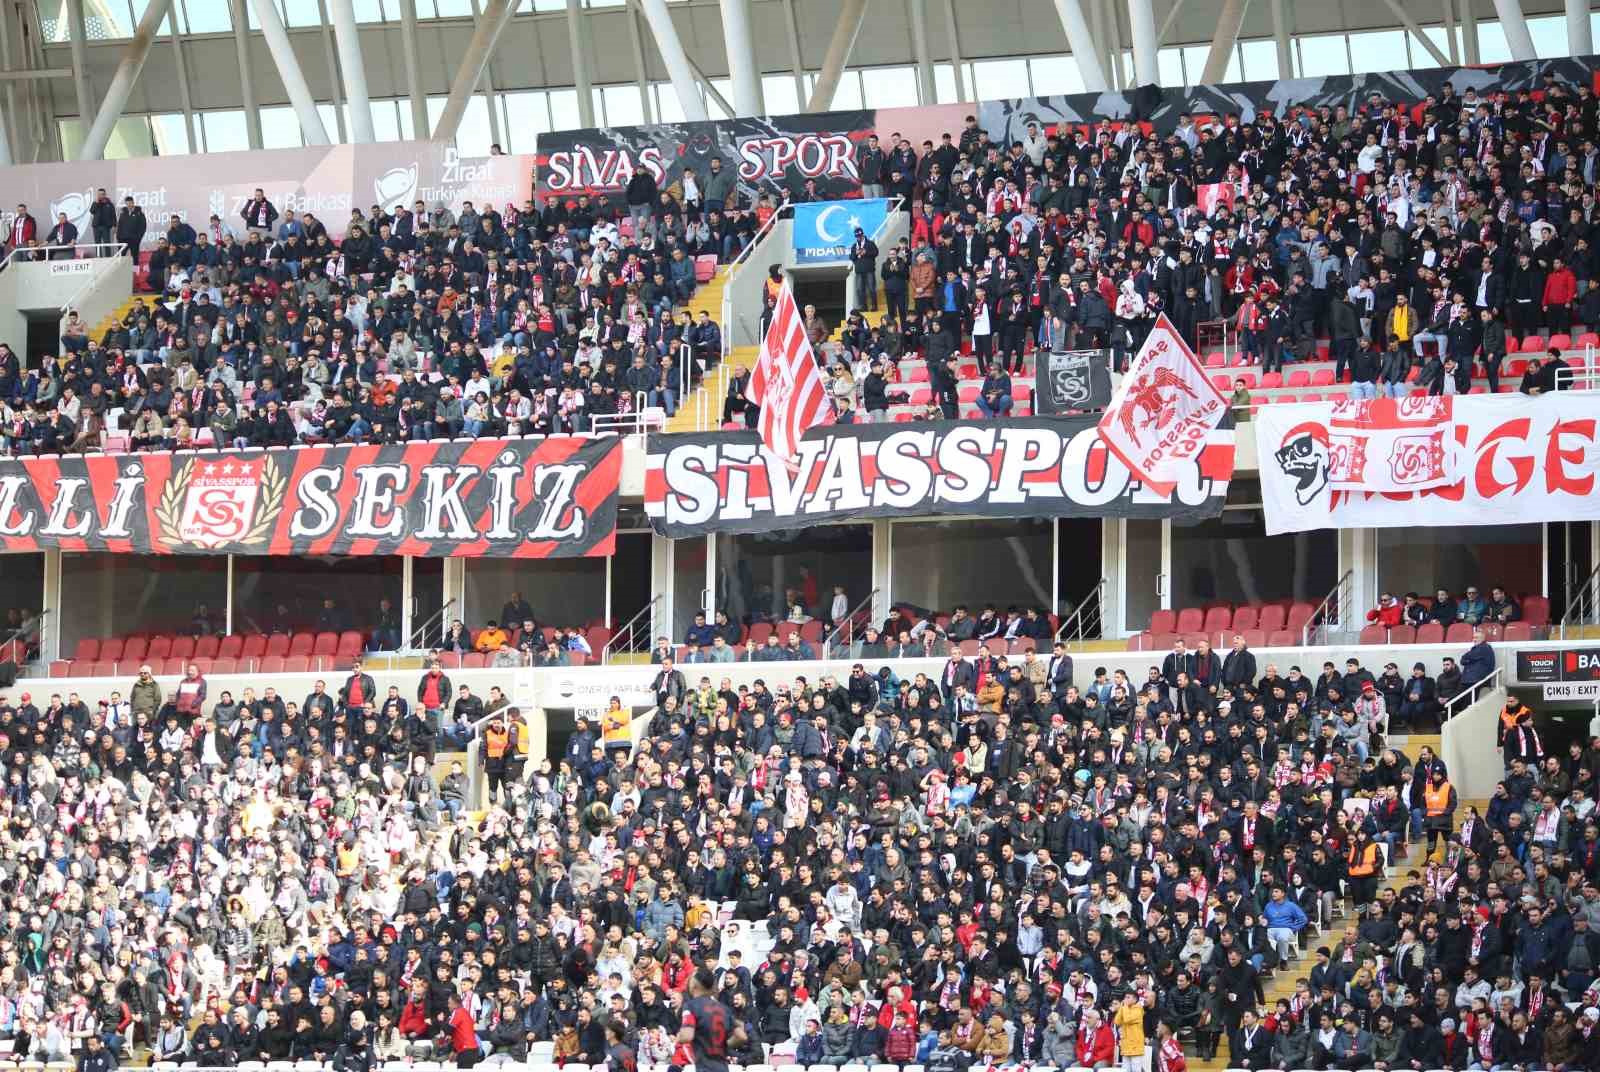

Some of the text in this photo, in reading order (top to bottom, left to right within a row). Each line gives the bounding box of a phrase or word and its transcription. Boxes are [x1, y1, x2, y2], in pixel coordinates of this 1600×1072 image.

[441, 161, 494, 182] Ziraat
[739, 135, 864, 184] SPOR
[293, 452, 588, 541] SEKİZ
[1578, 686, 1598, 695] EXIT
